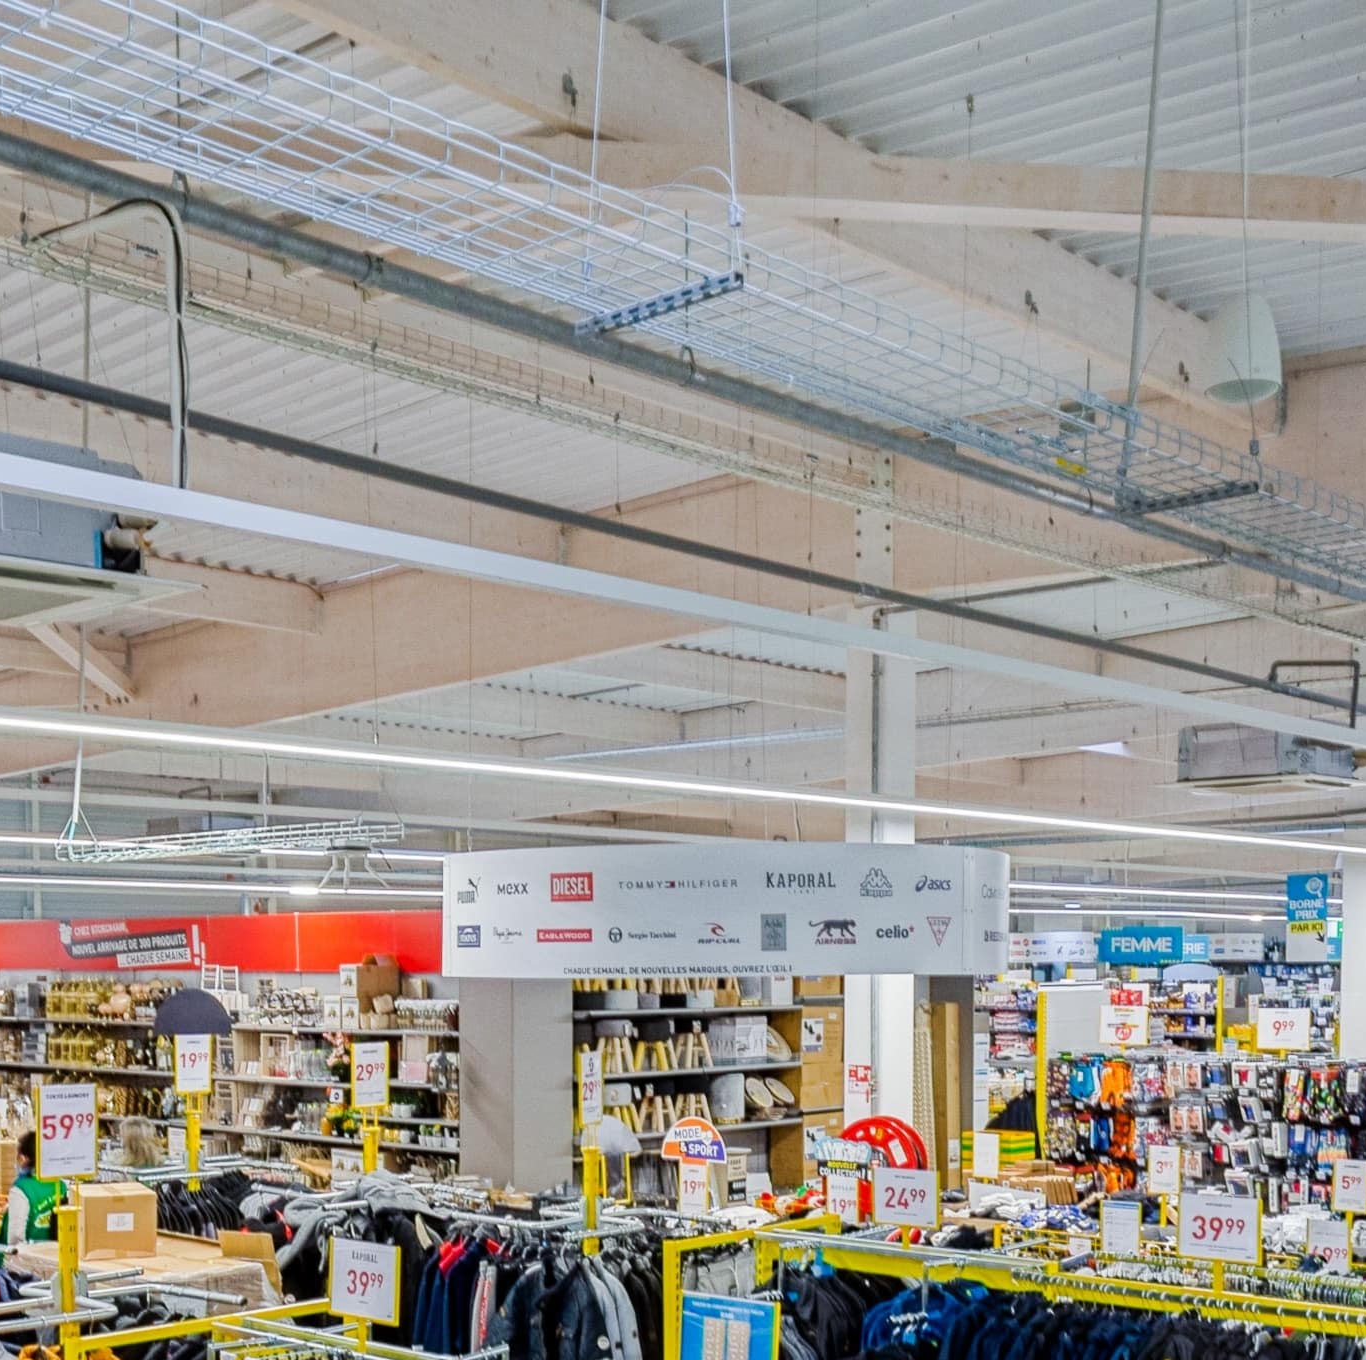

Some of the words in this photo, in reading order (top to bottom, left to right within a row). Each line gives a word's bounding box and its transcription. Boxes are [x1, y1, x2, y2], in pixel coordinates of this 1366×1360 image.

[553, 877, 591, 896] DIESEL
[618, 880, 664, 889] TOMMY
[678, 879, 738, 889] HILFIGER
[766, 871, 836, 889] KAPORAL
[1296, 910, 1319, 919] PRIX
[1111, 937, 1173, 953] FEMME
[641, 966, 686, 974] NOUVELLES
[732, 965, 764, 973] OUVREZ
[1273, 1020, 1295, 1036] 999
[180, 1052, 208, 1068] 1999
[356, 1063, 385, 1081] 2999
[42, 1113, 94, 1140] 5999
[674, 1128, 701, 1139] MODE
[688, 1145, 718, 1158] SPORT
[1342, 1175, 1362, 1189] 599
[885, 1187, 926, 1209] 2499
[1192, 1216, 1245, 1241] 3999
[346, 1269, 383, 1296] 3999
